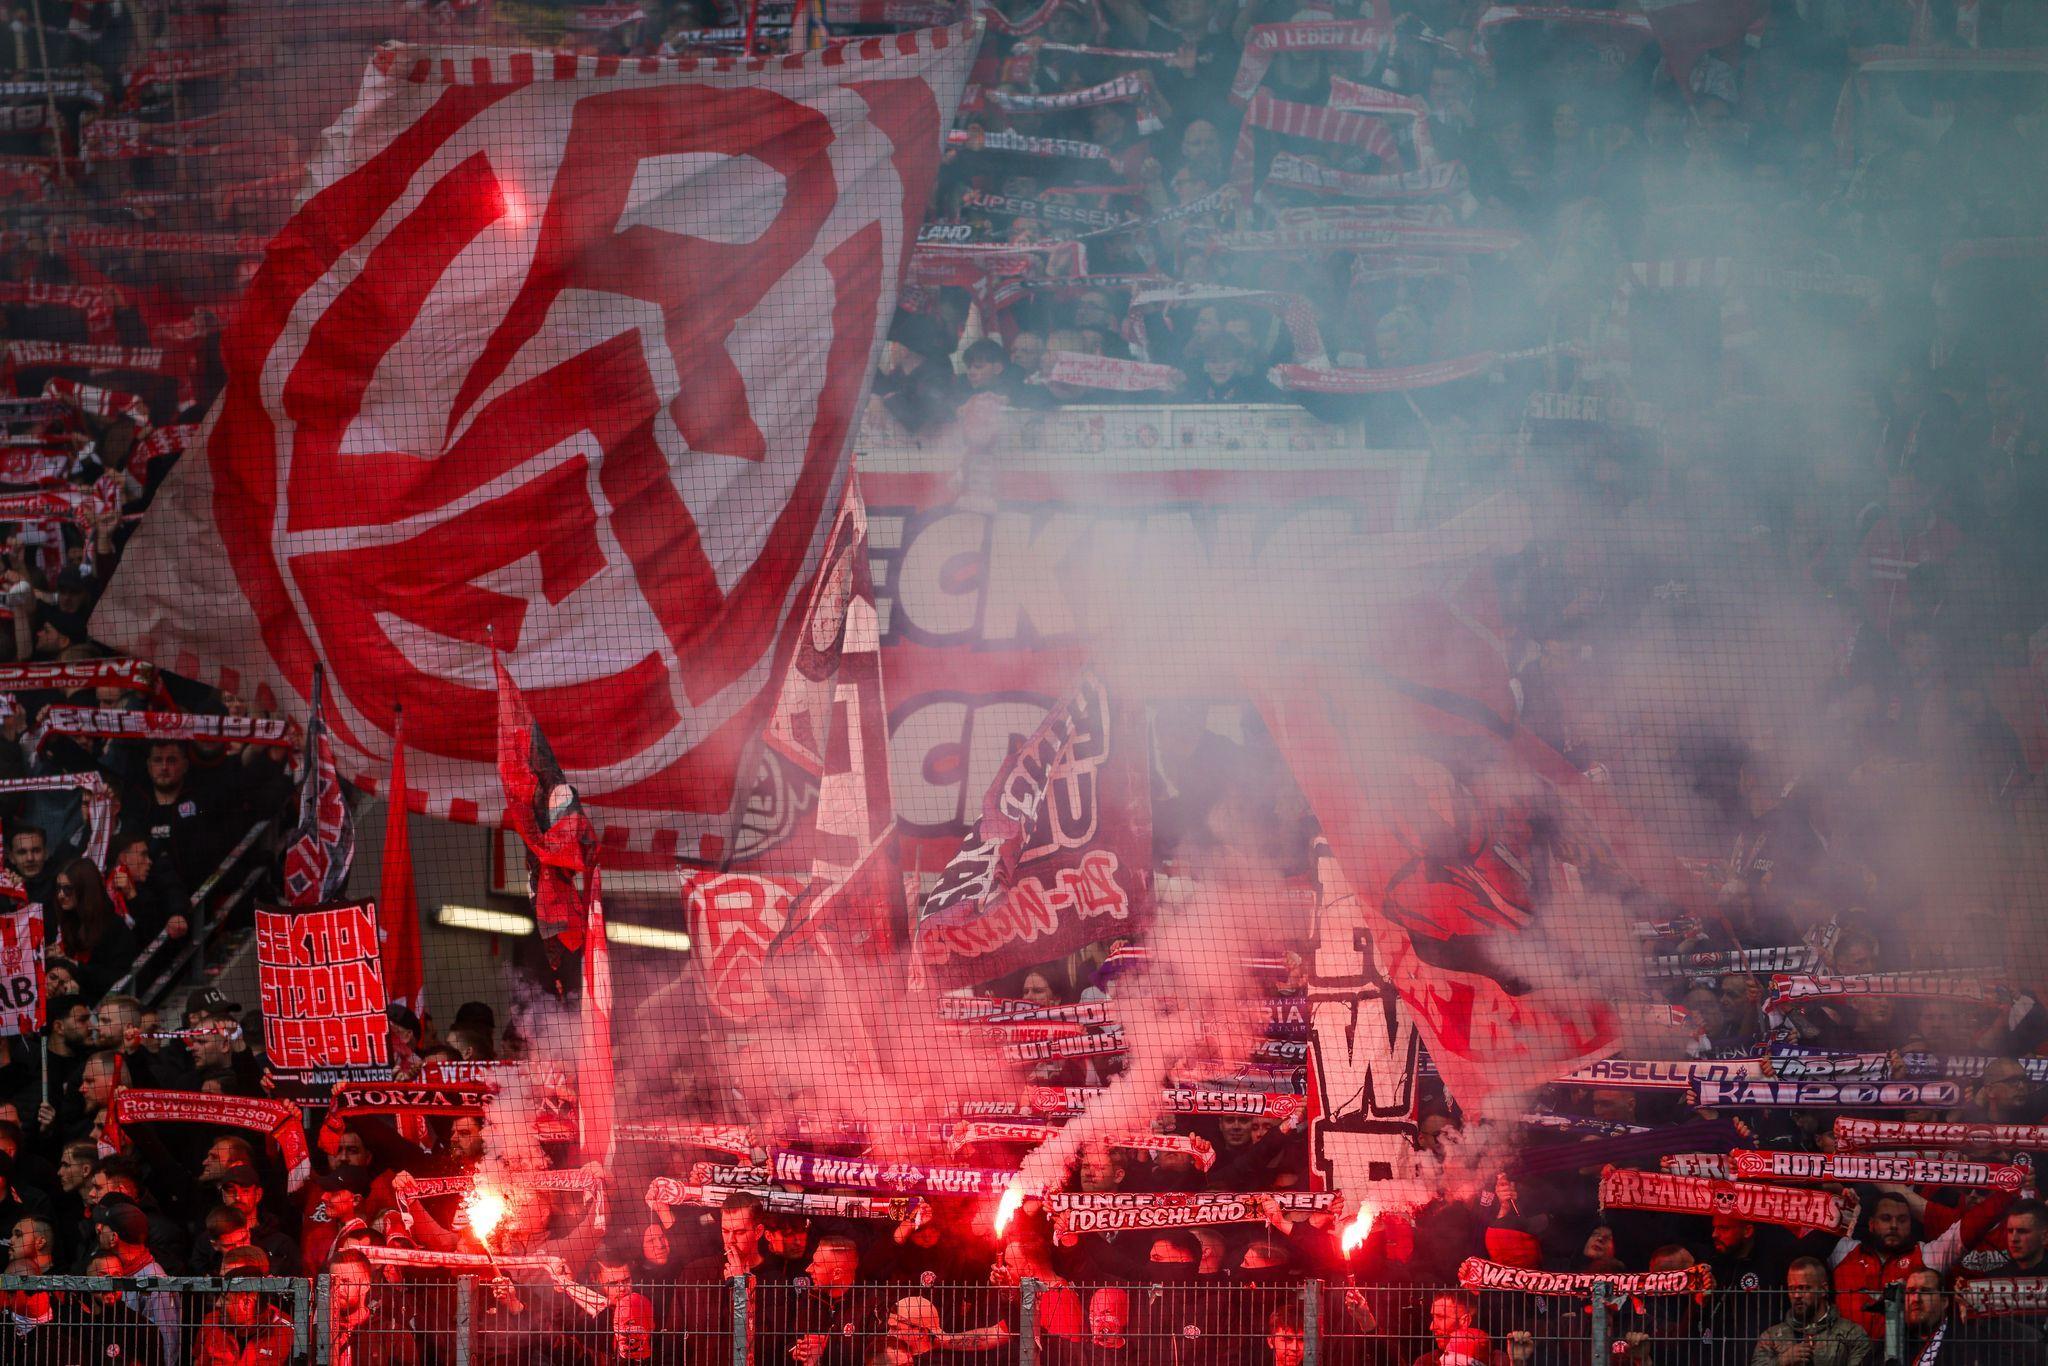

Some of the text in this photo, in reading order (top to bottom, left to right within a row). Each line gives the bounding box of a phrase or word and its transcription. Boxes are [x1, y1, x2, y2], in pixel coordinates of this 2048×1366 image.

[917, 225, 972, 241] LAND
[255, 903, 380, 967] SEKTION
[259, 957, 387, 1019] STADION
[1261, 1005, 1304, 1024] RIA
[264, 1013, 390, 1069] VERBOT
[343, 1089, 452, 1108] FORZA
[963, 1101, 1016, 1115] IMMER
[776, 1153, 804, 1181] IN
[813, 1158, 879, 1188] WIEN
[927, 1169, 982, 1194] NUR
[1773, 1154, 1989, 1184] ROT-WEISS ESSEN
[1050, 1193, 1155, 1212] JUNGE
[1604, 1171, 1712, 1209] FREAKS
[1069, 1202, 1245, 1232] DEUTSCHLAND
